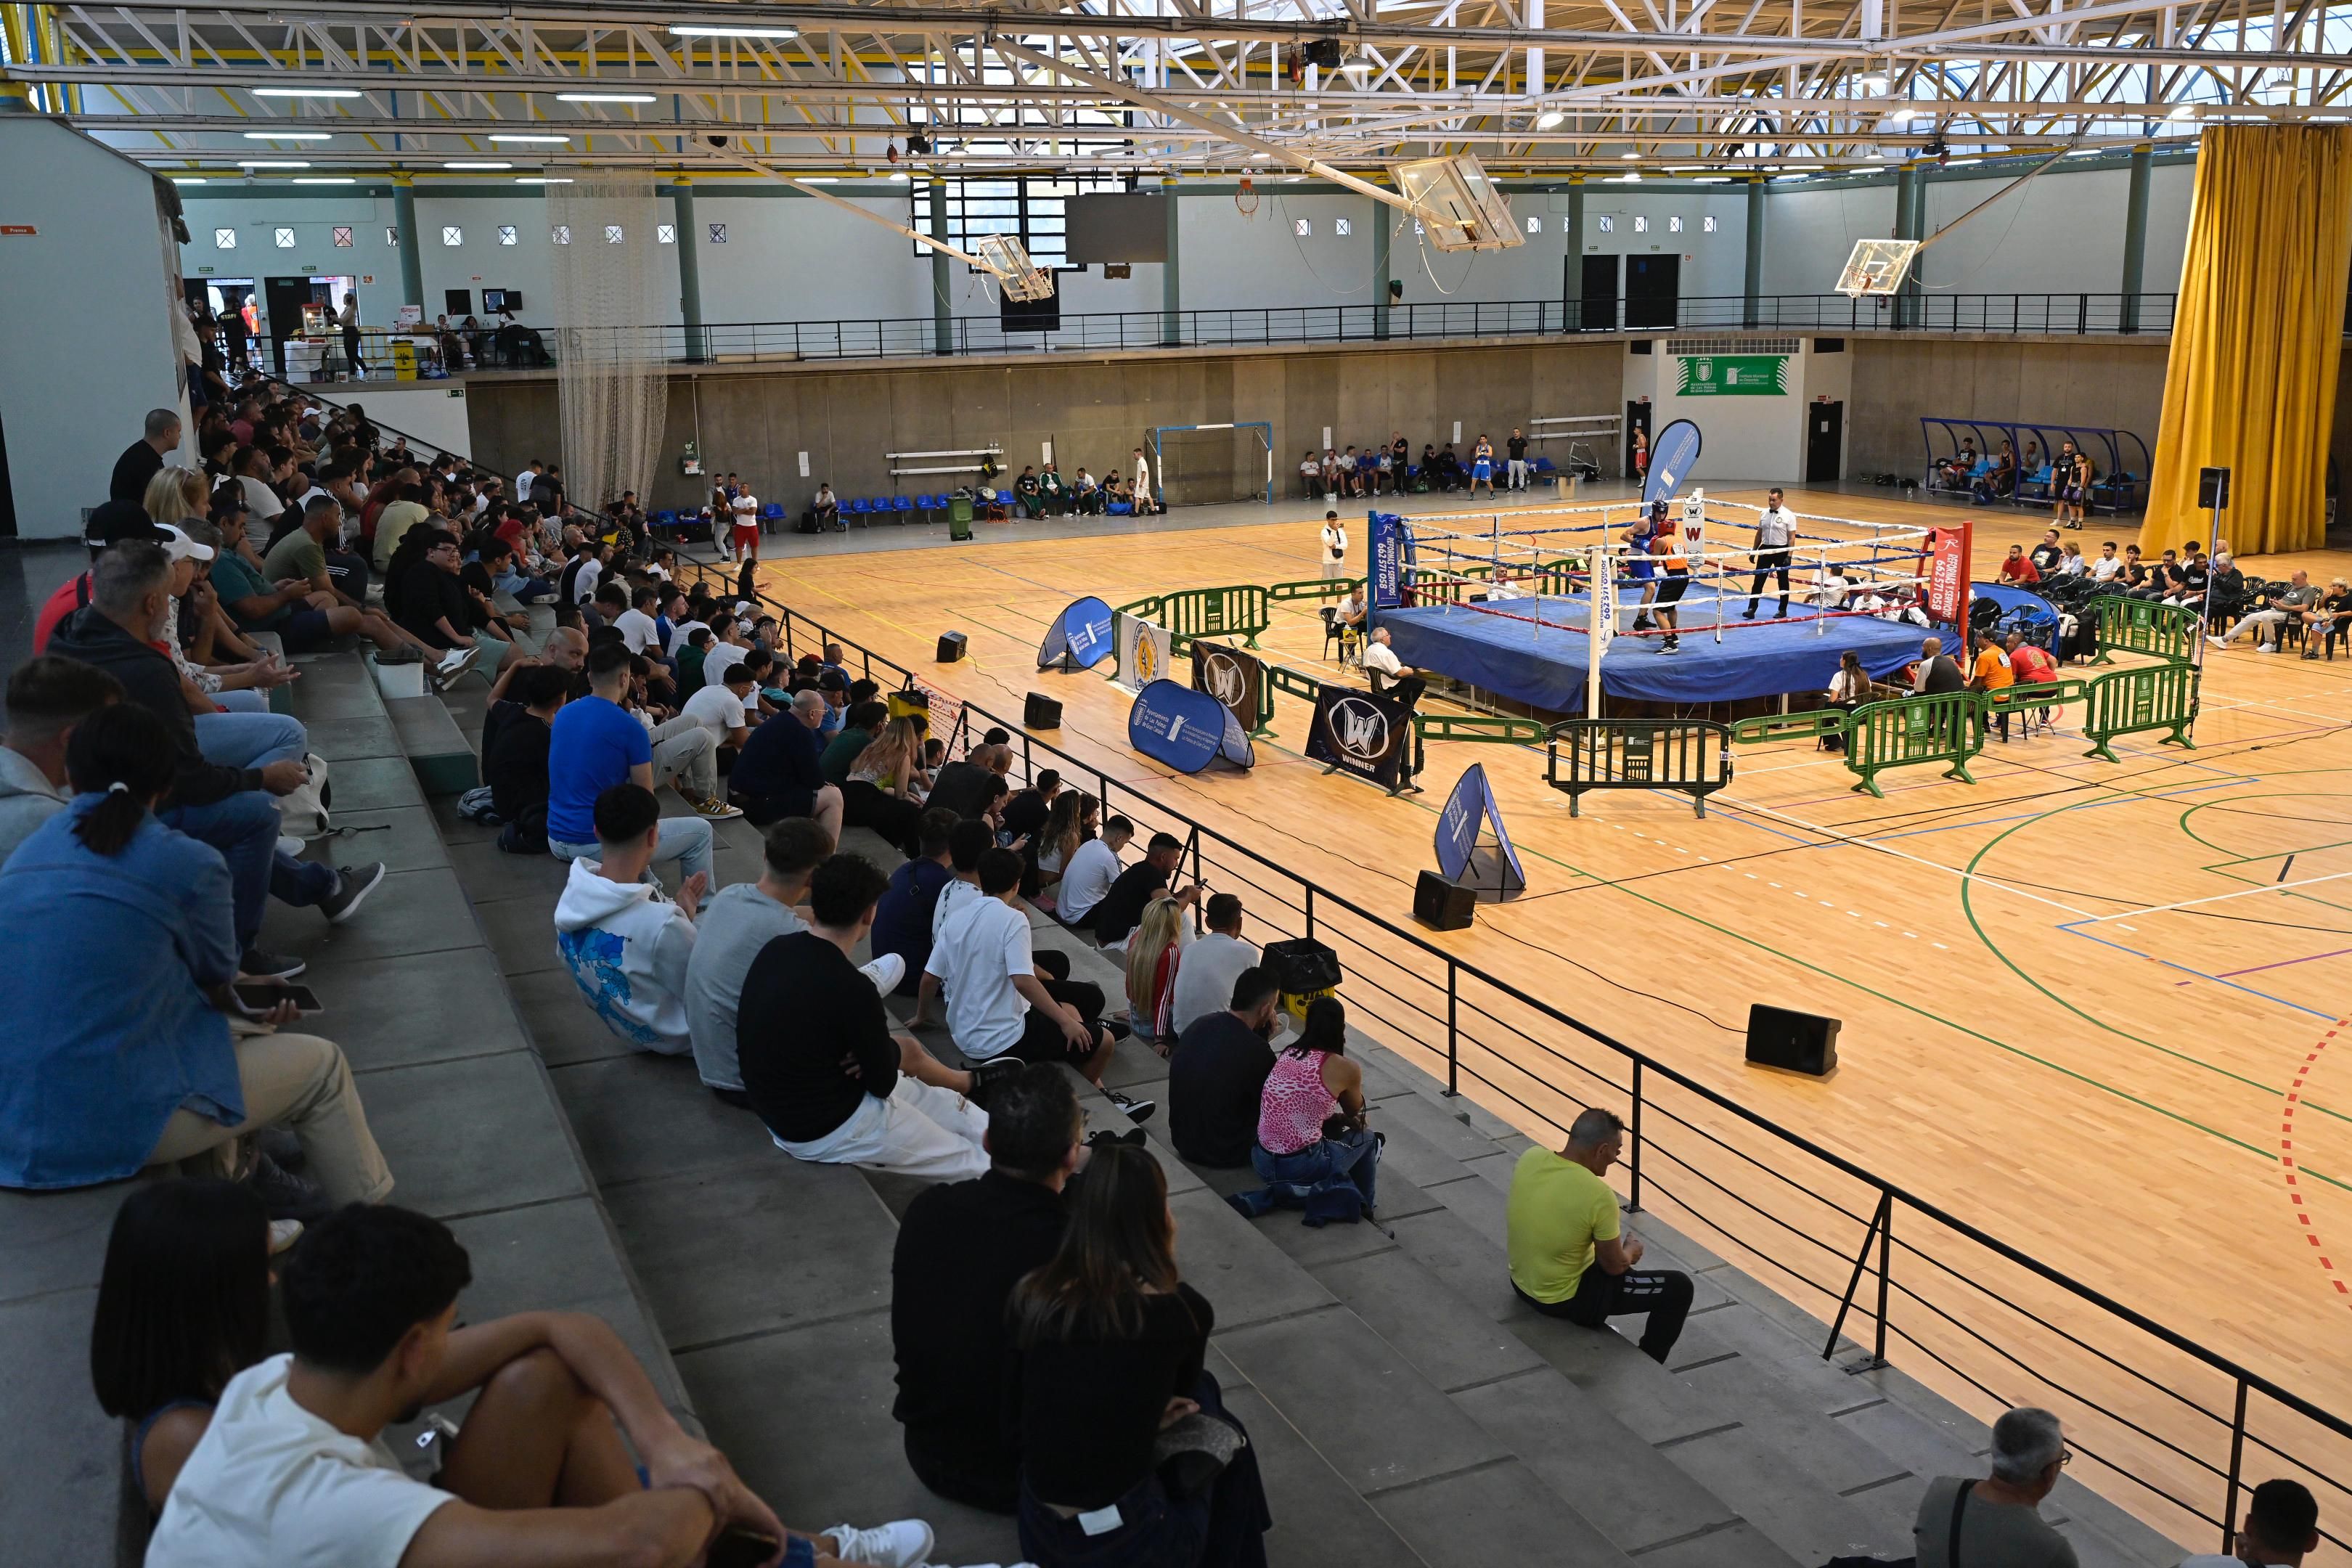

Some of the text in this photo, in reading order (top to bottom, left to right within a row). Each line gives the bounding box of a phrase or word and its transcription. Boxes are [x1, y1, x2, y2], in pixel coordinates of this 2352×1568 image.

[1378, 543, 1388, 589] 662 571 058
[1945, 553, 1959, 585] REFORMAS
[1387, 570, 1396, 597] SERVICIOS
[1931, 560, 1945, 611] 662 571 058
[1942, 589, 1954, 618] SERVICIOS
[1146, 708, 1169, 723] Ayuntamiento
[1156, 719, 1167, 730] Palmas
[1153, 726, 1164, 736] Canaria
[1342, 754, 1376, 773] WINNER
